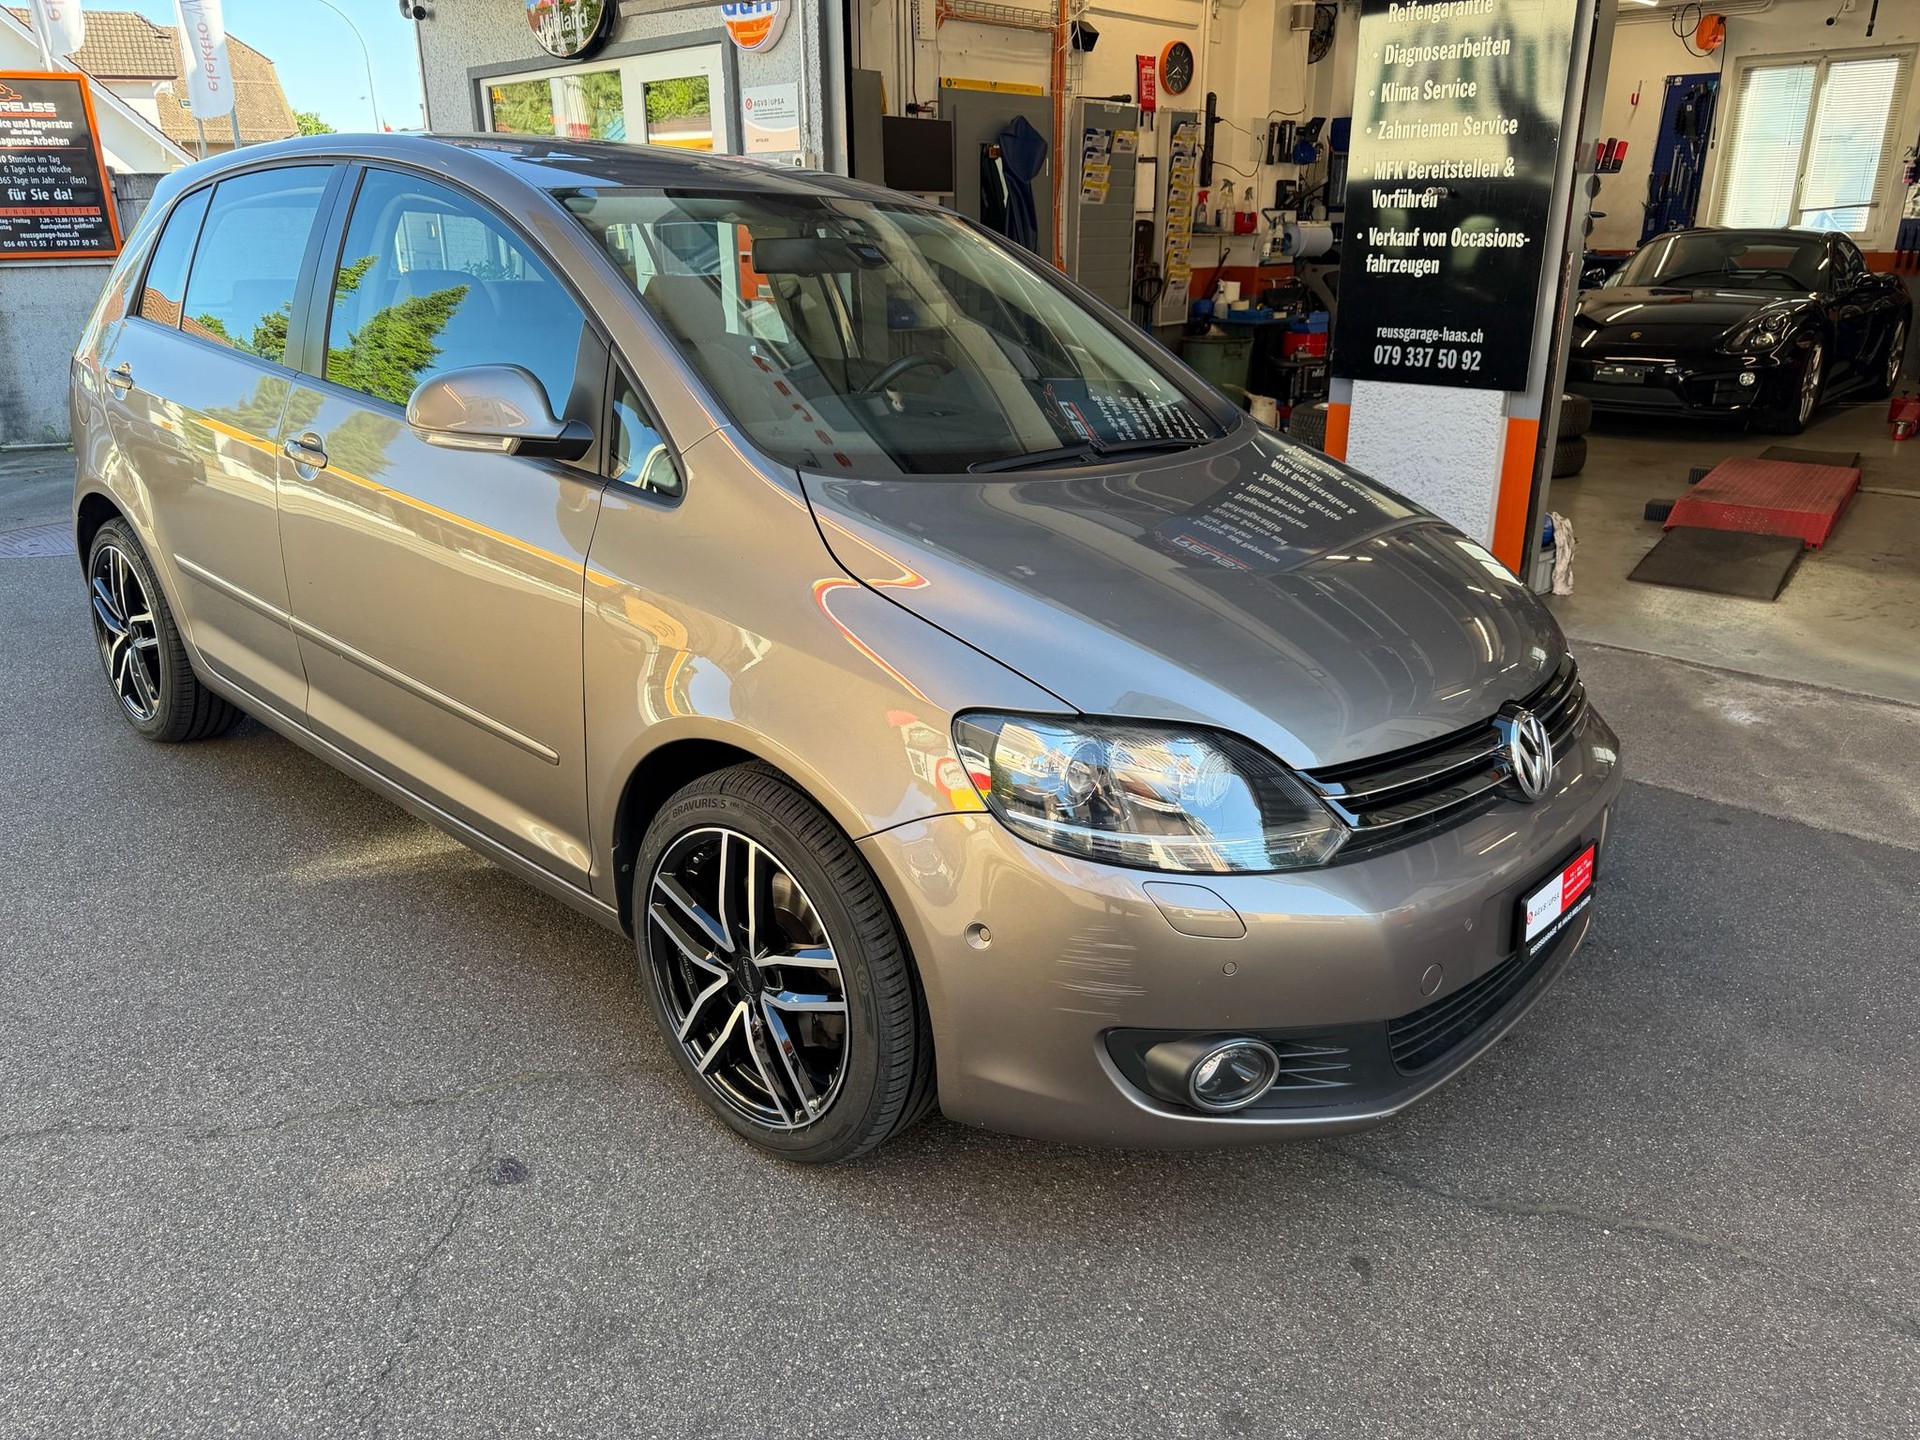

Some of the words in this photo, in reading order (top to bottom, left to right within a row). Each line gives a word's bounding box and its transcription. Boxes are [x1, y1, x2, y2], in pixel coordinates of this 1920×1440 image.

[539, 7, 588, 32] Midland
[1388, 0, 1493, 24] Reifengarantie
[1384, 37, 1510, 67] Diagnosearbeiten
[1381, 81, 1420, 103] Klima
[1423, 77, 1476, 101] Service
[13, 119, 29, 128] und
[30, 120, 73, 130] Reparatur
[1378, 119, 1459, 141] Zahnriemen
[1463, 115, 1519, 138] Service
[9, 155, 36, 163] Stunden
[48, 156, 60, 164] Tag
[10, 166, 26, 174] Tage
[1374, 161, 1404, 181] MFK
[1407, 158, 1498, 180] Bereitstellen
[1503, 157, 1516, 178] &
[12, 177, 28, 185] Tage
[70, 176, 87, 185] (fast)
[8, 188, 26, 200] für
[31, 188, 49, 200] Sie
[54, 188, 73, 200] da!
[1371, 188, 1438, 210] Vorführen
[20, 231, 79, 239] reussgarage-haas.ch
[1368, 227, 1420, 248] Verkauf
[1423, 229, 1446, 247] von
[1450, 227, 1531, 249] Occasions-
[1366, 254, 1440, 278] fahrzeugen
[1376, 324, 1484, 345] reussgarage-haas.ch
[1374, 344, 1401, 366] 079
[1405, 347, 1432, 368] 337
[1437, 348, 1458, 370] 50
[1461, 350, 1482, 371] 92
[673, 798, 718, 818] BRAVURIS
[720, 799, 727, 809] 5
